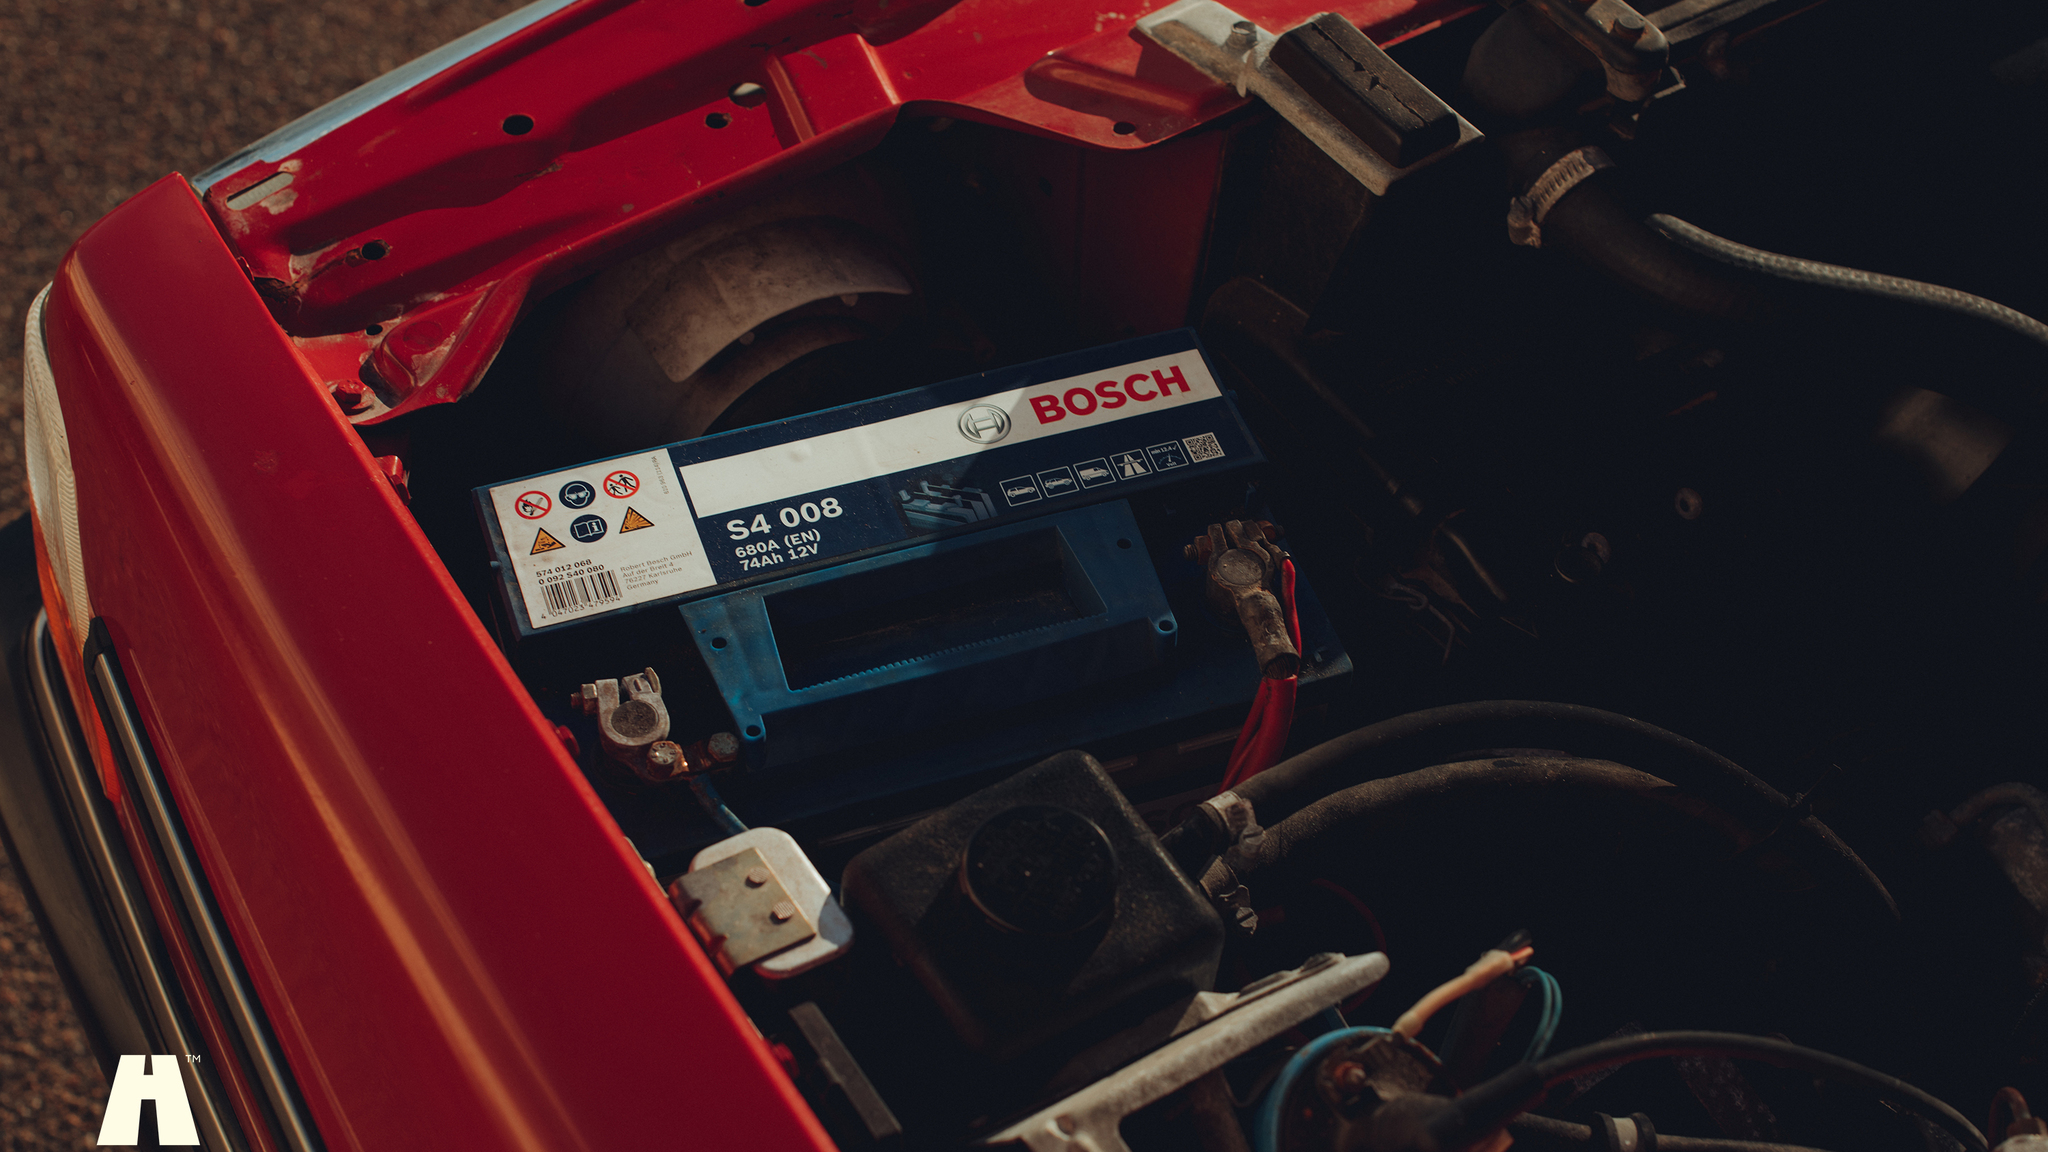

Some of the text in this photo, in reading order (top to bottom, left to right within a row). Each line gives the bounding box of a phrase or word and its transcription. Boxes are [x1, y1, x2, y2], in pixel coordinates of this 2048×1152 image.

[1029, 365, 1191, 425] BOSCH
[726, 497, 843, 540] S4 008
[735, 528, 821, 558] 680A (EN)
[536, 558, 592, 578] 574 012 068
[620, 550, 693, 572] Robert Bosch GmbH
[739, 543, 818, 572] 74Ah 12V
[547, 574, 564, 584] 092
[587, 563, 605, 574] 080
[622, 570, 635, 578] Auf
[636, 567, 648, 575] der
[649, 563, 668, 572] Breit
[624, 567, 683, 584] 76227 Karlsruhe
[626, 579, 659, 590] Germany
